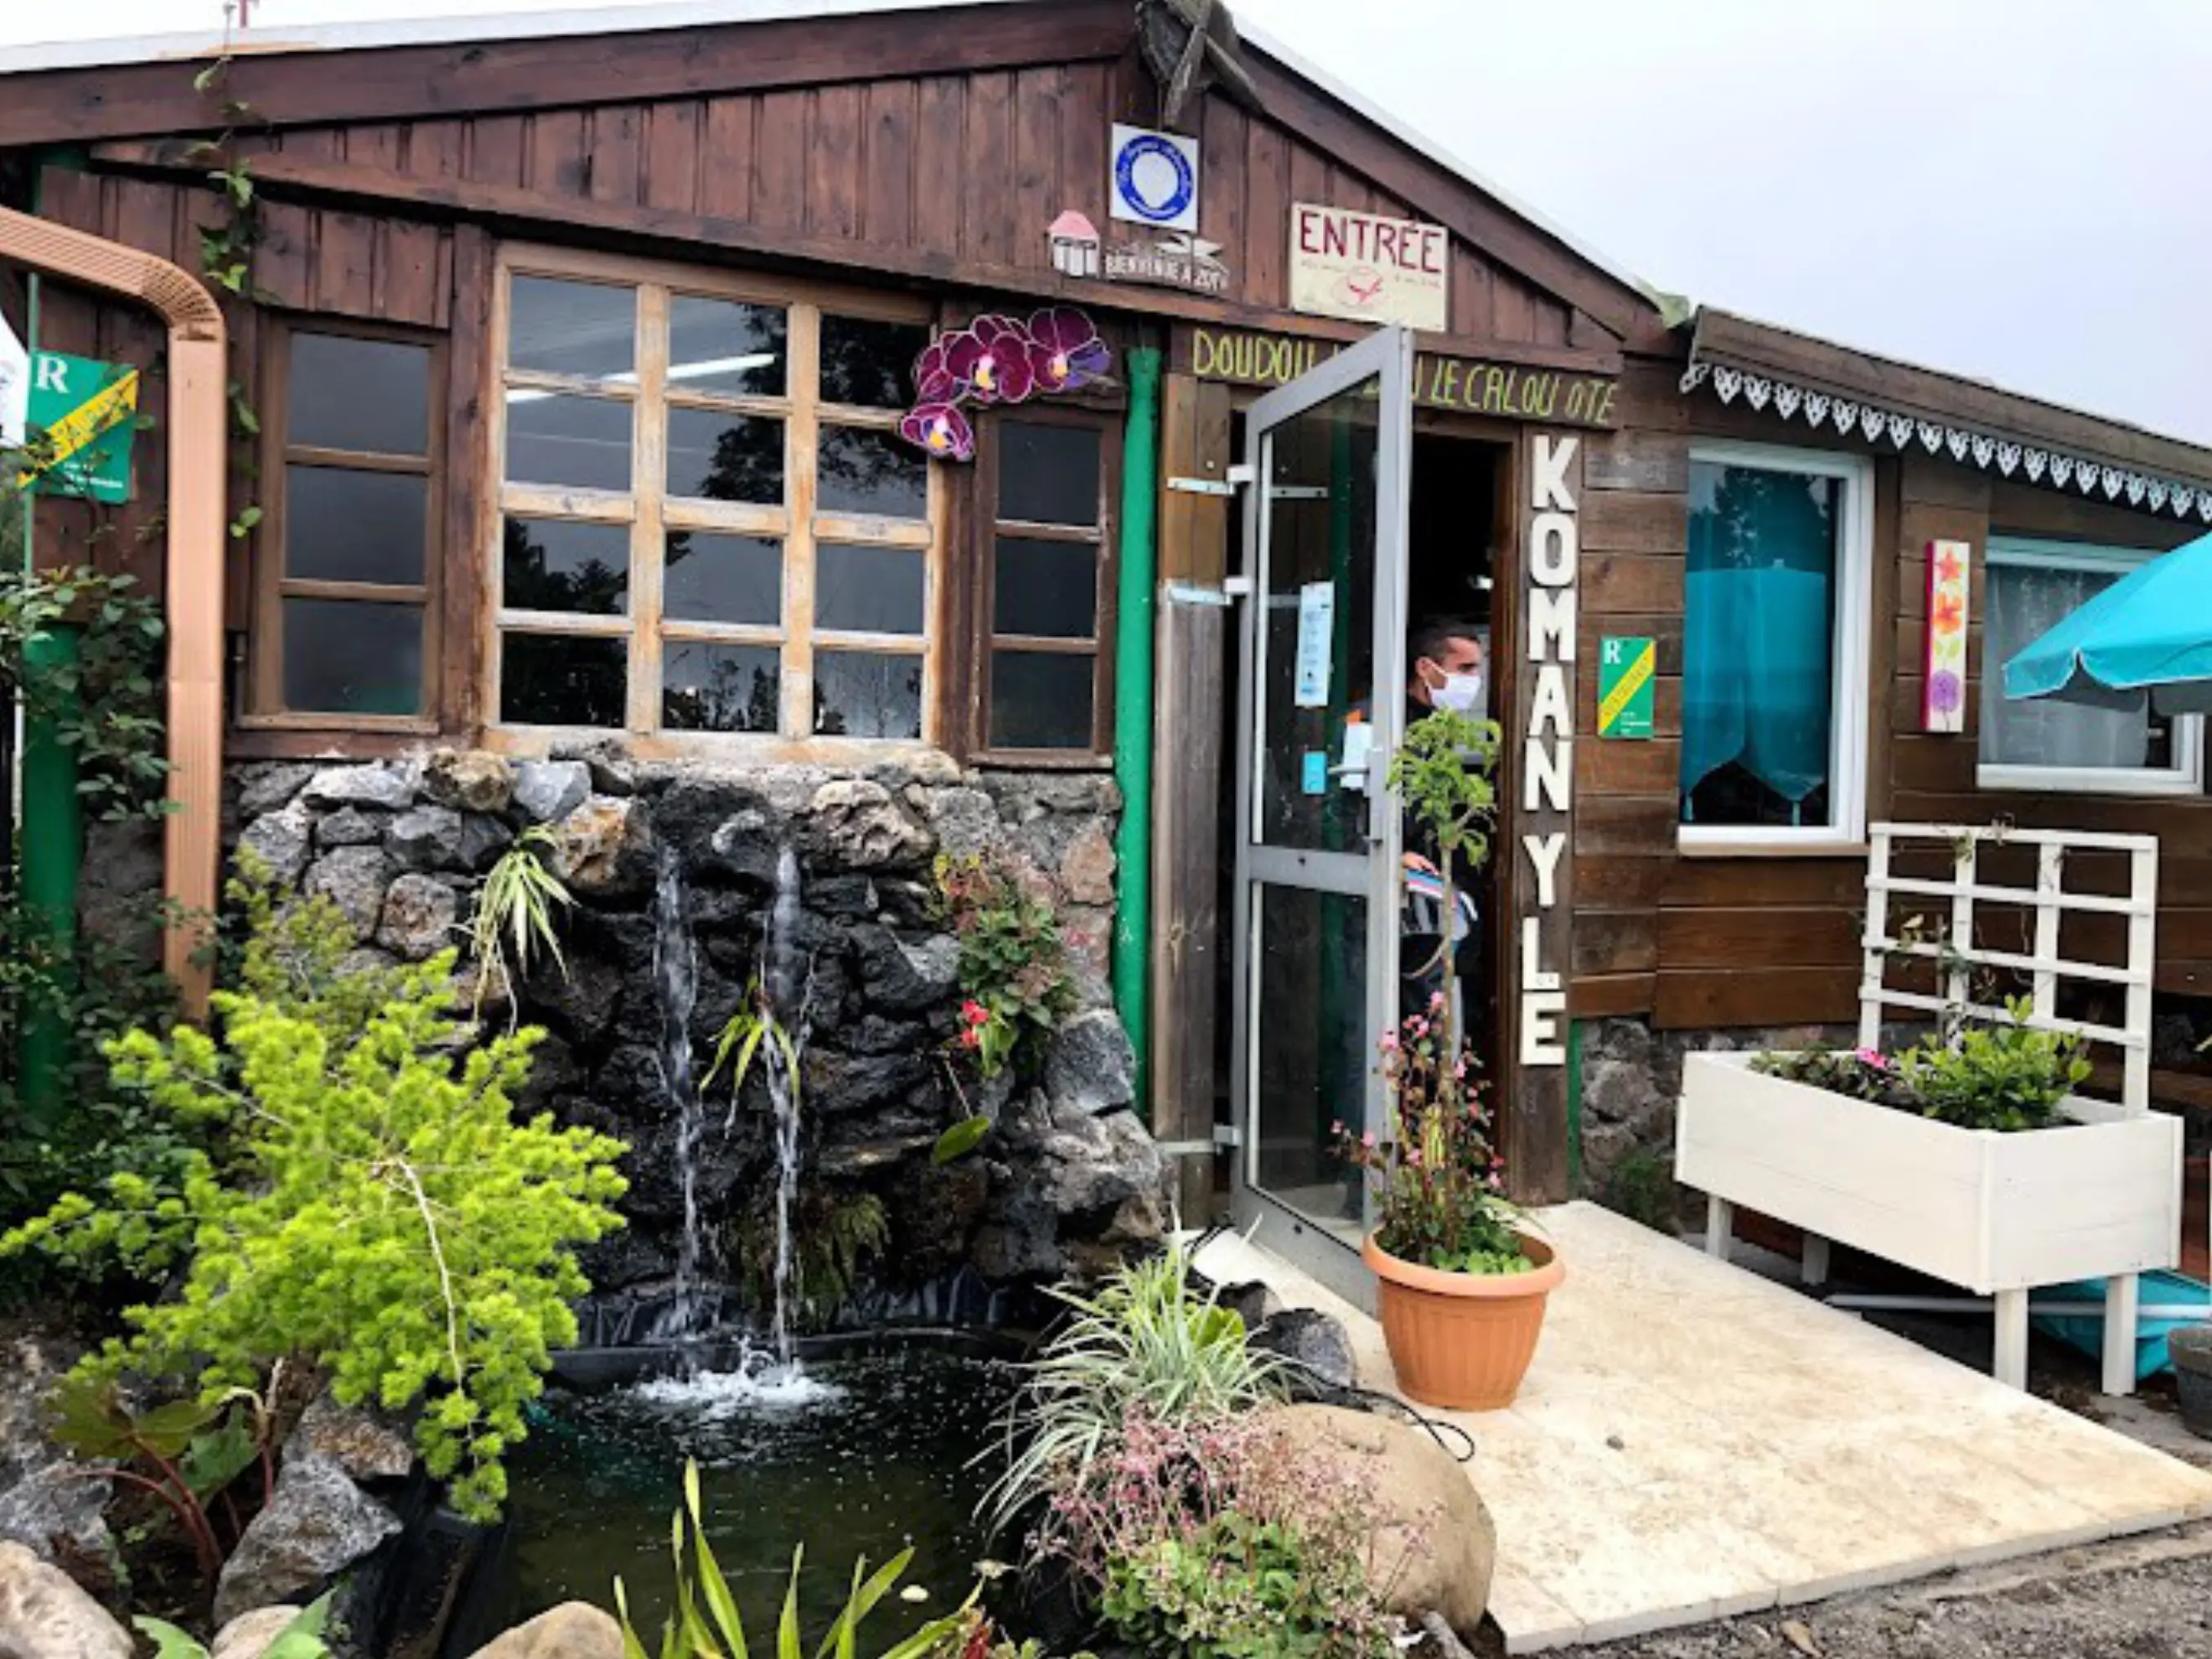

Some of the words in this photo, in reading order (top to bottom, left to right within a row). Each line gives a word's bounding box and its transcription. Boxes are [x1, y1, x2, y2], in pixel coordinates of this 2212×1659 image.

[1300, 210, 1442, 273] ENTRÉE
[35, 355, 70, 393] R
[1429, 357, 1461, 406] LE
[1604, 639, 1622, 664] R
[1519, 434, 1579, 1065] KOMANYLE
